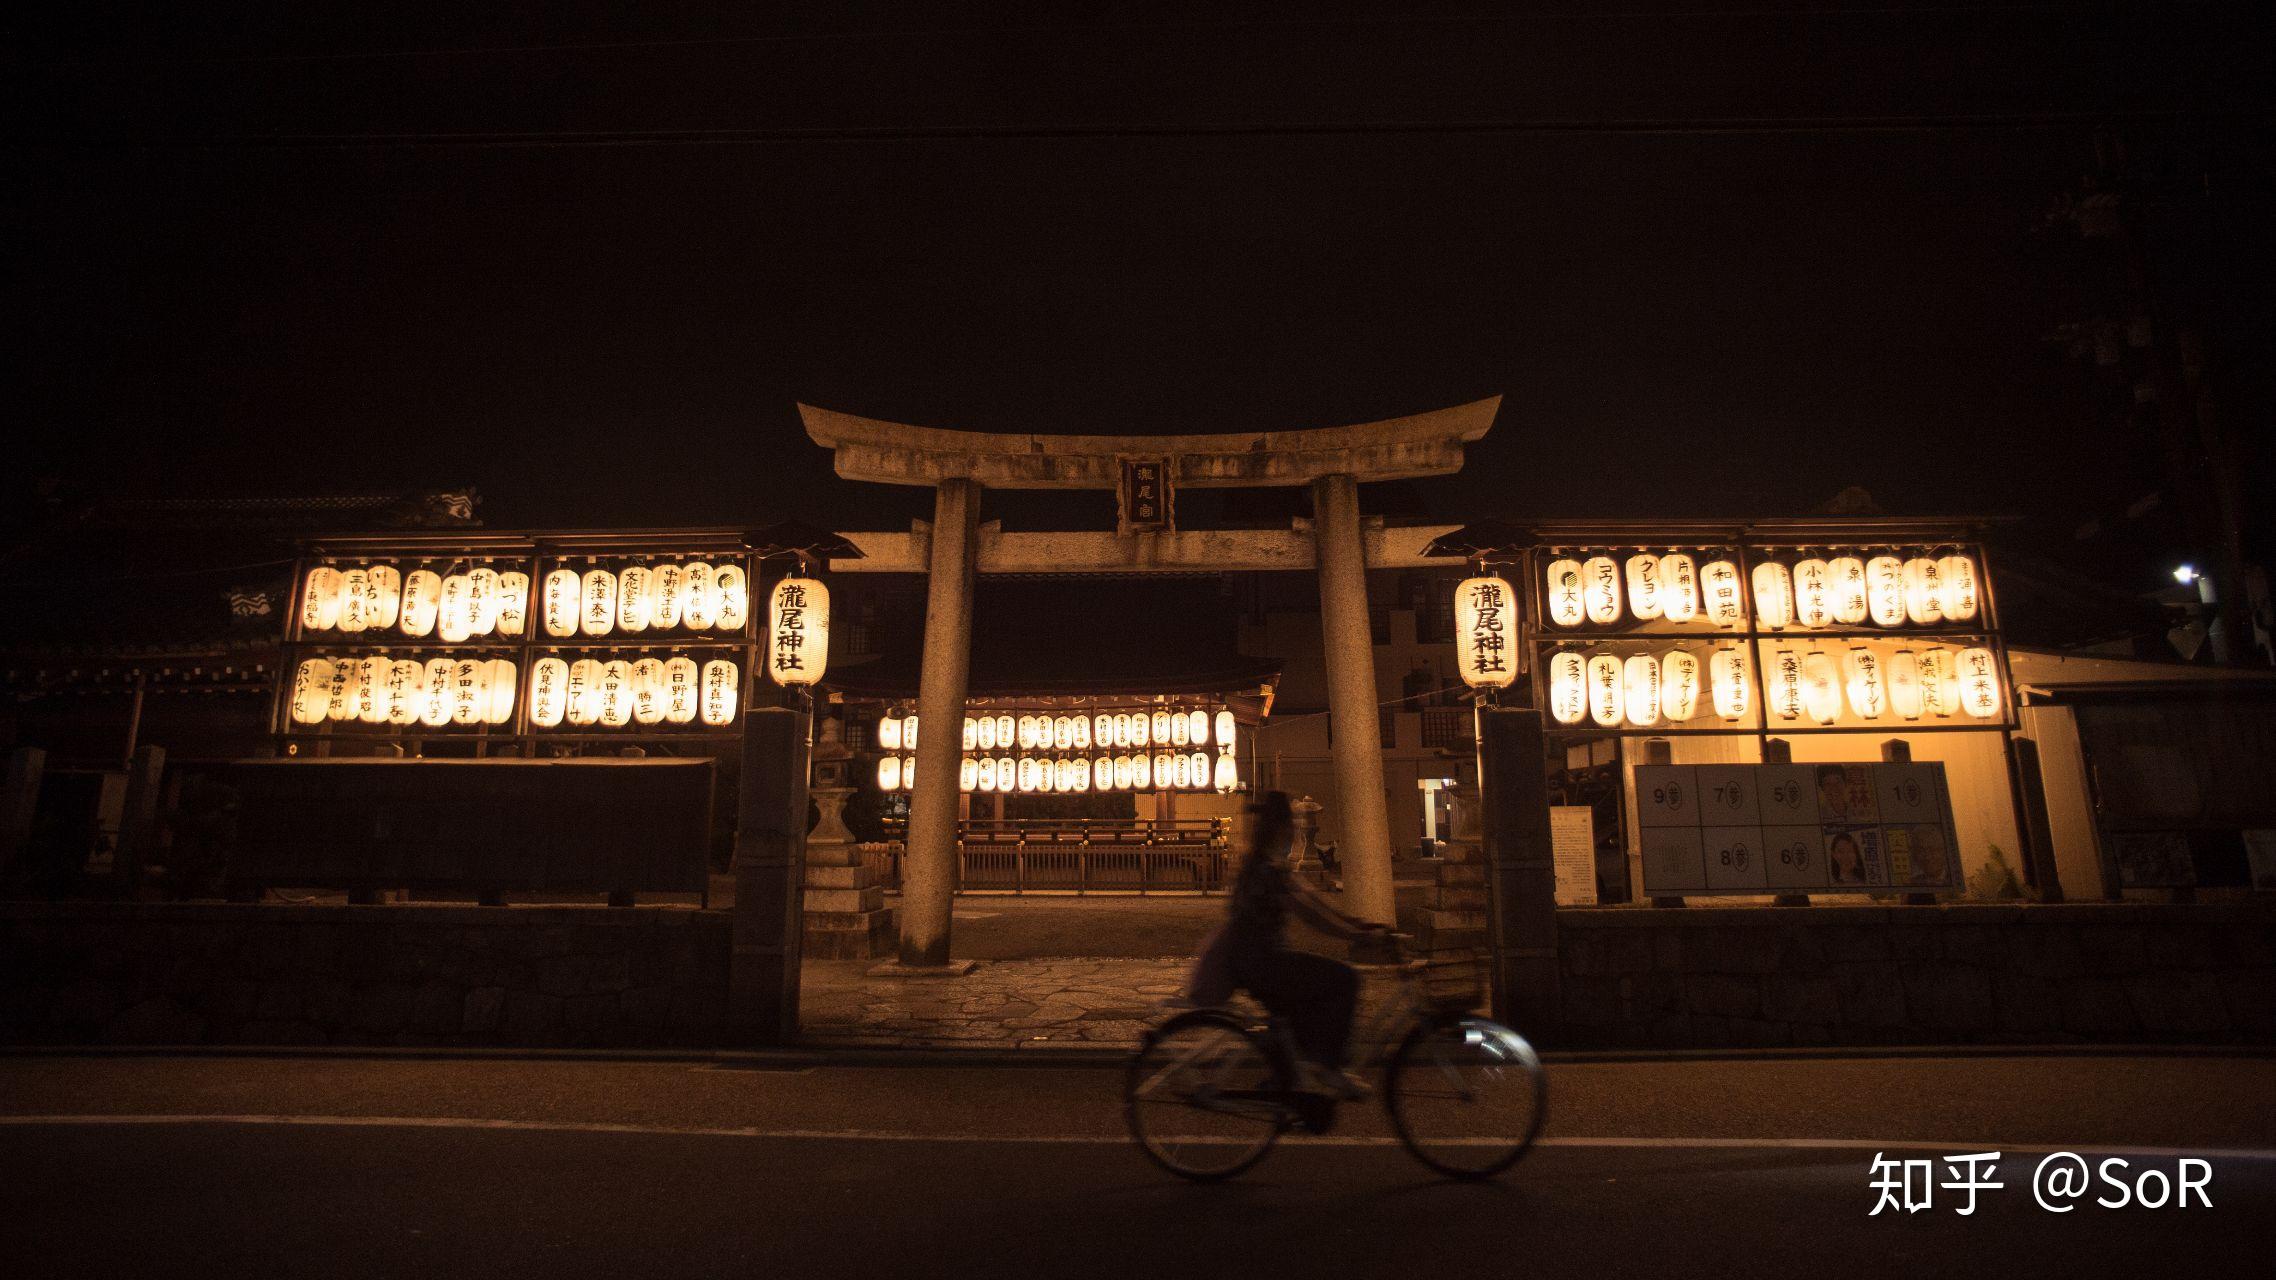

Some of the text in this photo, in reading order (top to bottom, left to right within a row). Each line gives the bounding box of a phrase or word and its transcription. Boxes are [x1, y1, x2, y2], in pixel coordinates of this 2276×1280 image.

[366, 572, 378, 617] いちい
[1599, 564, 1614, 616] コウミョウ
[1640, 560, 1656, 610] クレヨン
[1712, 568, 1738, 618] 和田苑
[1847, 566, 1864, 610] 泉湯
[720, 591, 736, 619] 大丸
[1562, 589, 1577, 618] 大丸
[776, 585, 807, 672] 瀧尾神社
[1471, 584, 1506, 674] 瀧尾神社
[329, 661, 349, 710] 中西哲郎
[1653, 788, 1664, 804] 9
[1713, 787, 1723, 803] 7
[1774, 786, 1784, 802] 5
[1893, 785, 1902, 801] 1
[1720, 850, 1730, 866] 8
[1781, 848, 1791, 864] 6
